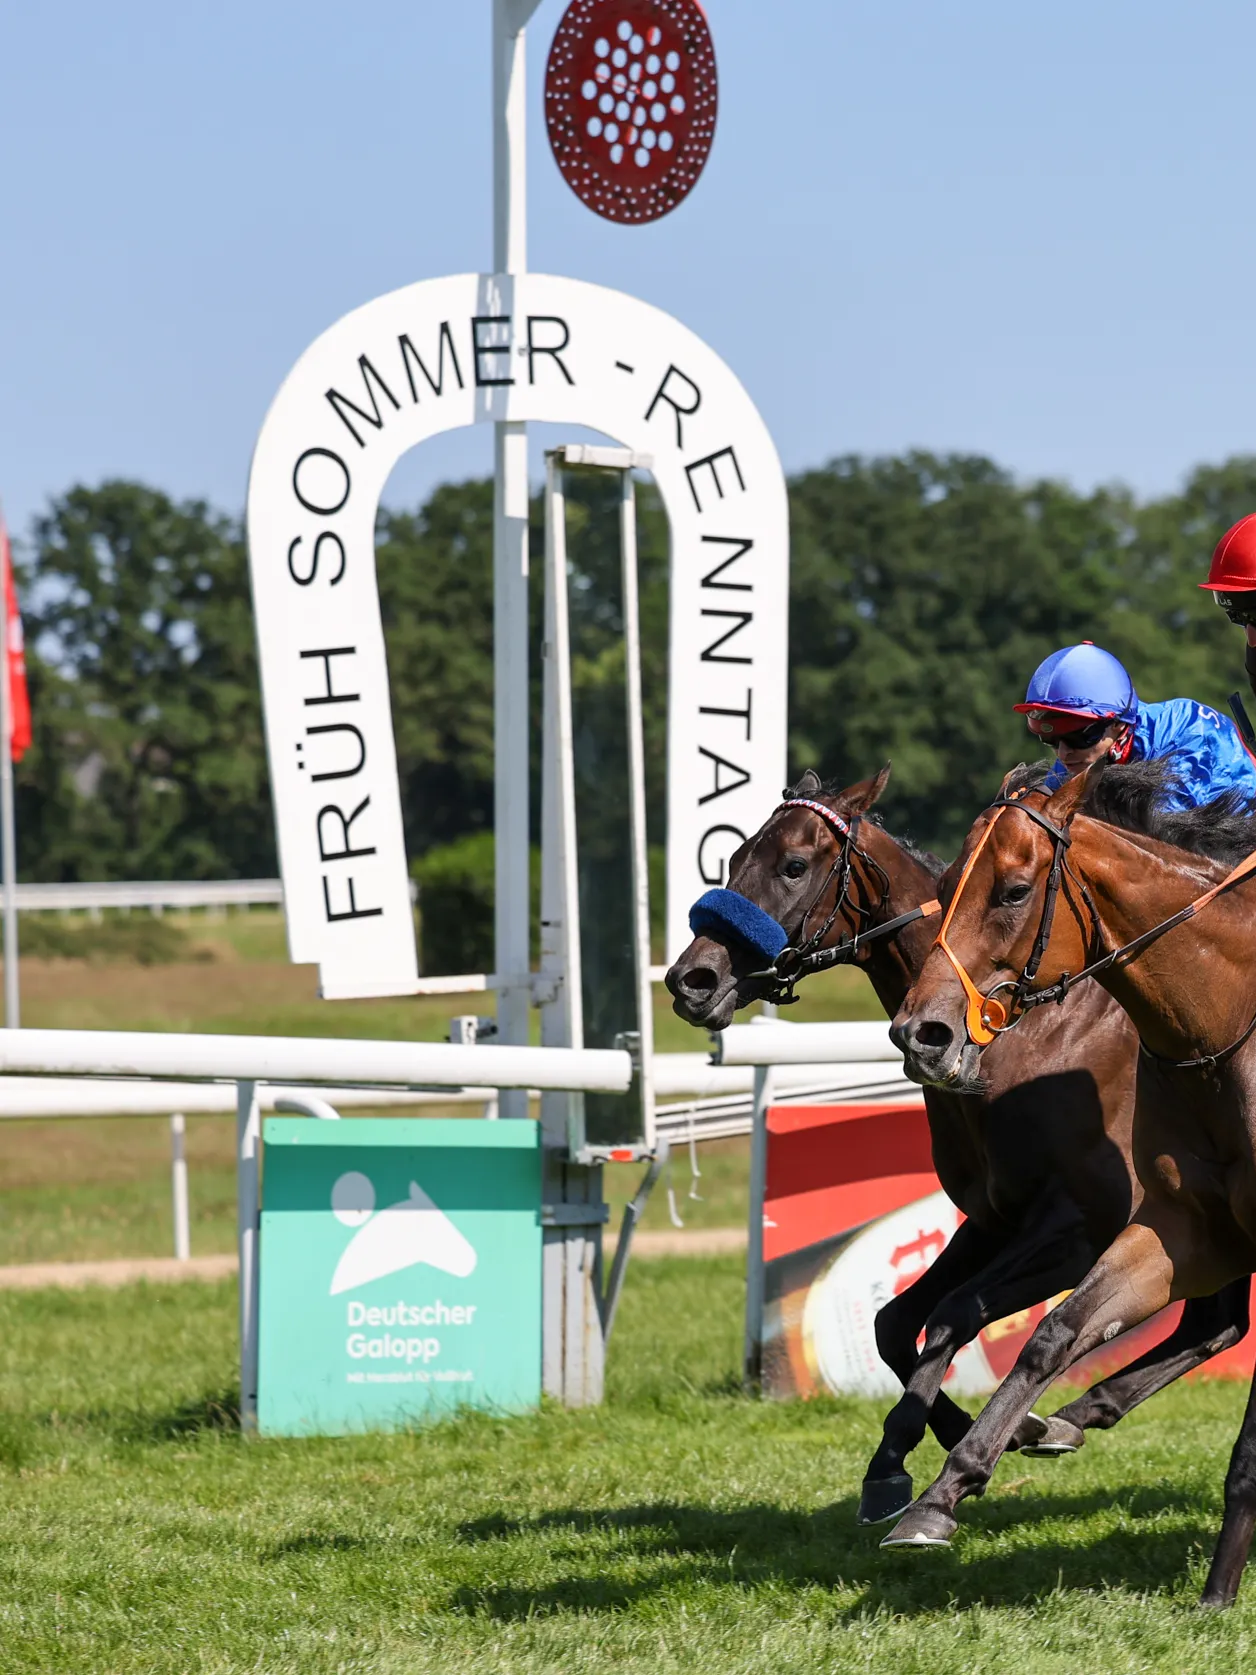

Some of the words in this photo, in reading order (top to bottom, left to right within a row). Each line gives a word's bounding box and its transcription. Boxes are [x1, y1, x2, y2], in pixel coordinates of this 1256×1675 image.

[297, 645, 383, 924] FRÜH
[347, 1299, 478, 1327] Deutscher
[346, 1332, 441, 1365] Galopp
